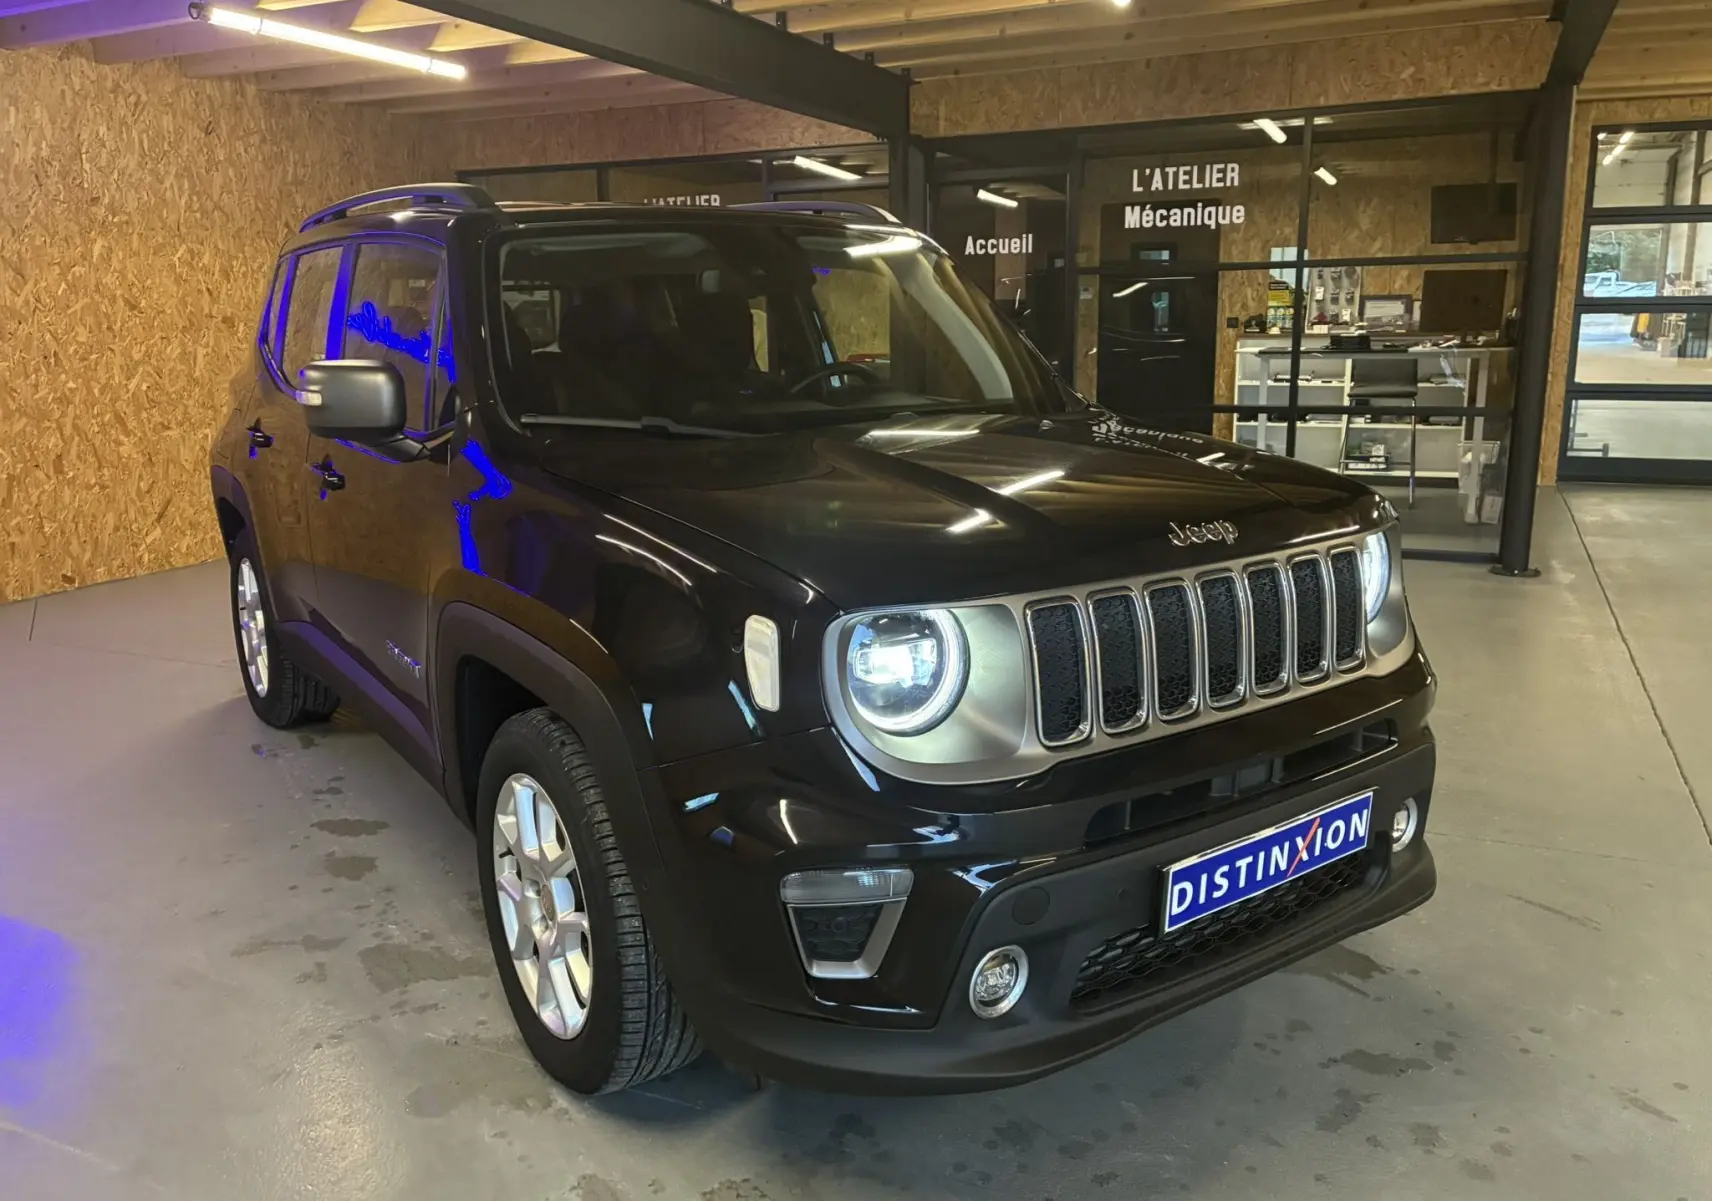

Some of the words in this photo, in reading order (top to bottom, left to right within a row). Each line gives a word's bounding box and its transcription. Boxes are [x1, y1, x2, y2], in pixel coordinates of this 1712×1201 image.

[1132, 163, 1240, 192] L'ATELIER
[643, 194, 721, 206] 'ATELIER
[1124, 202, 1245, 229] Mécanique
[964, 234, 1033, 255] Accueil
[1168, 520, 1239, 546] Jeep
[1171, 808, 1368, 915] DISTINXION
